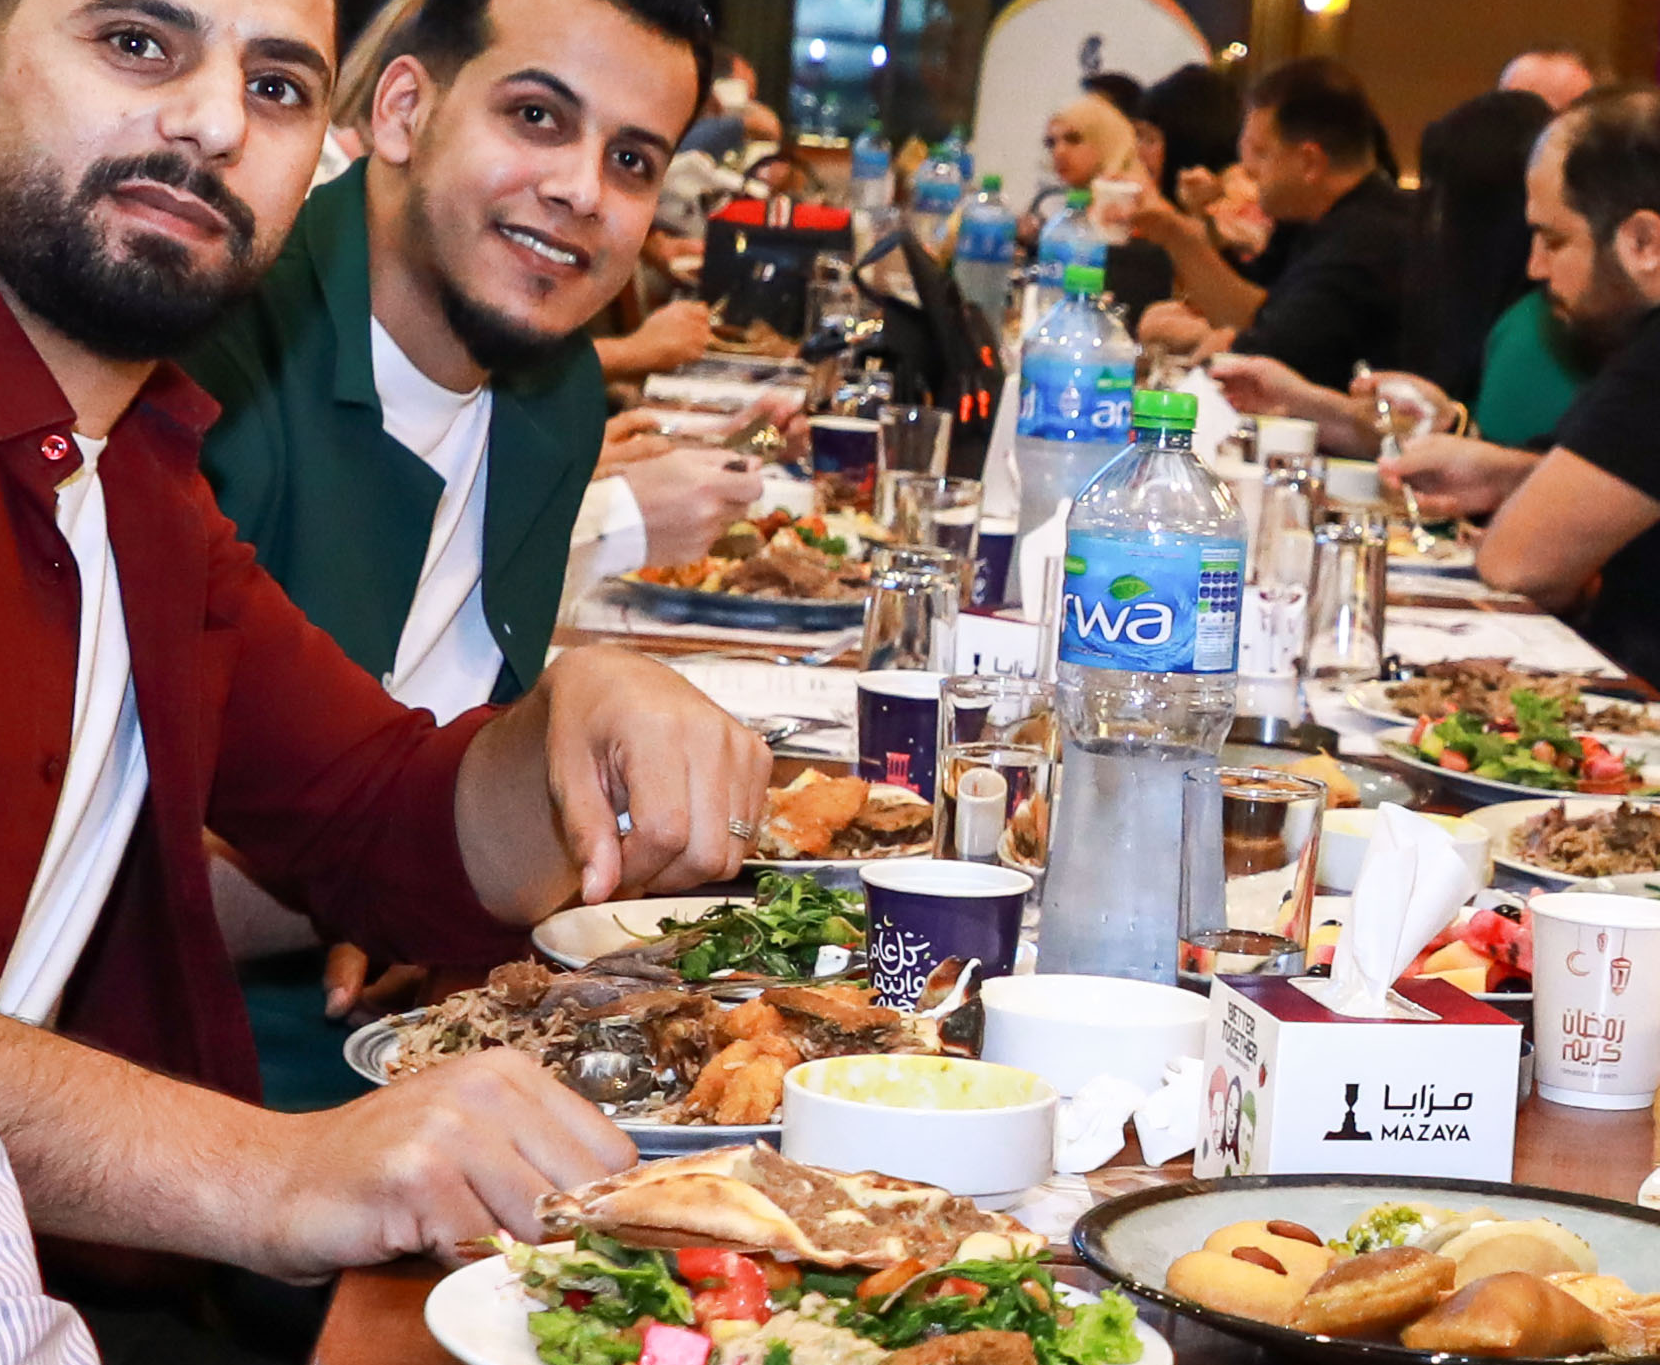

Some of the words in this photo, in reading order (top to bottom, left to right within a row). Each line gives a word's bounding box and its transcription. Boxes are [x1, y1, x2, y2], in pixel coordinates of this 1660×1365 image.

[1062, 592, 1174, 646] rwa
[1227, 1000, 1256, 1038] BETTER
[1562, 1009, 1625, 1044] رمضان
[1221, 1018, 1259, 1066] TOGETHER
[1562, 1038, 1623, 1067] كريم
[1383, 1083, 1474, 1119] مزايا
[1380, 1123, 1471, 1141] MAZAYA
